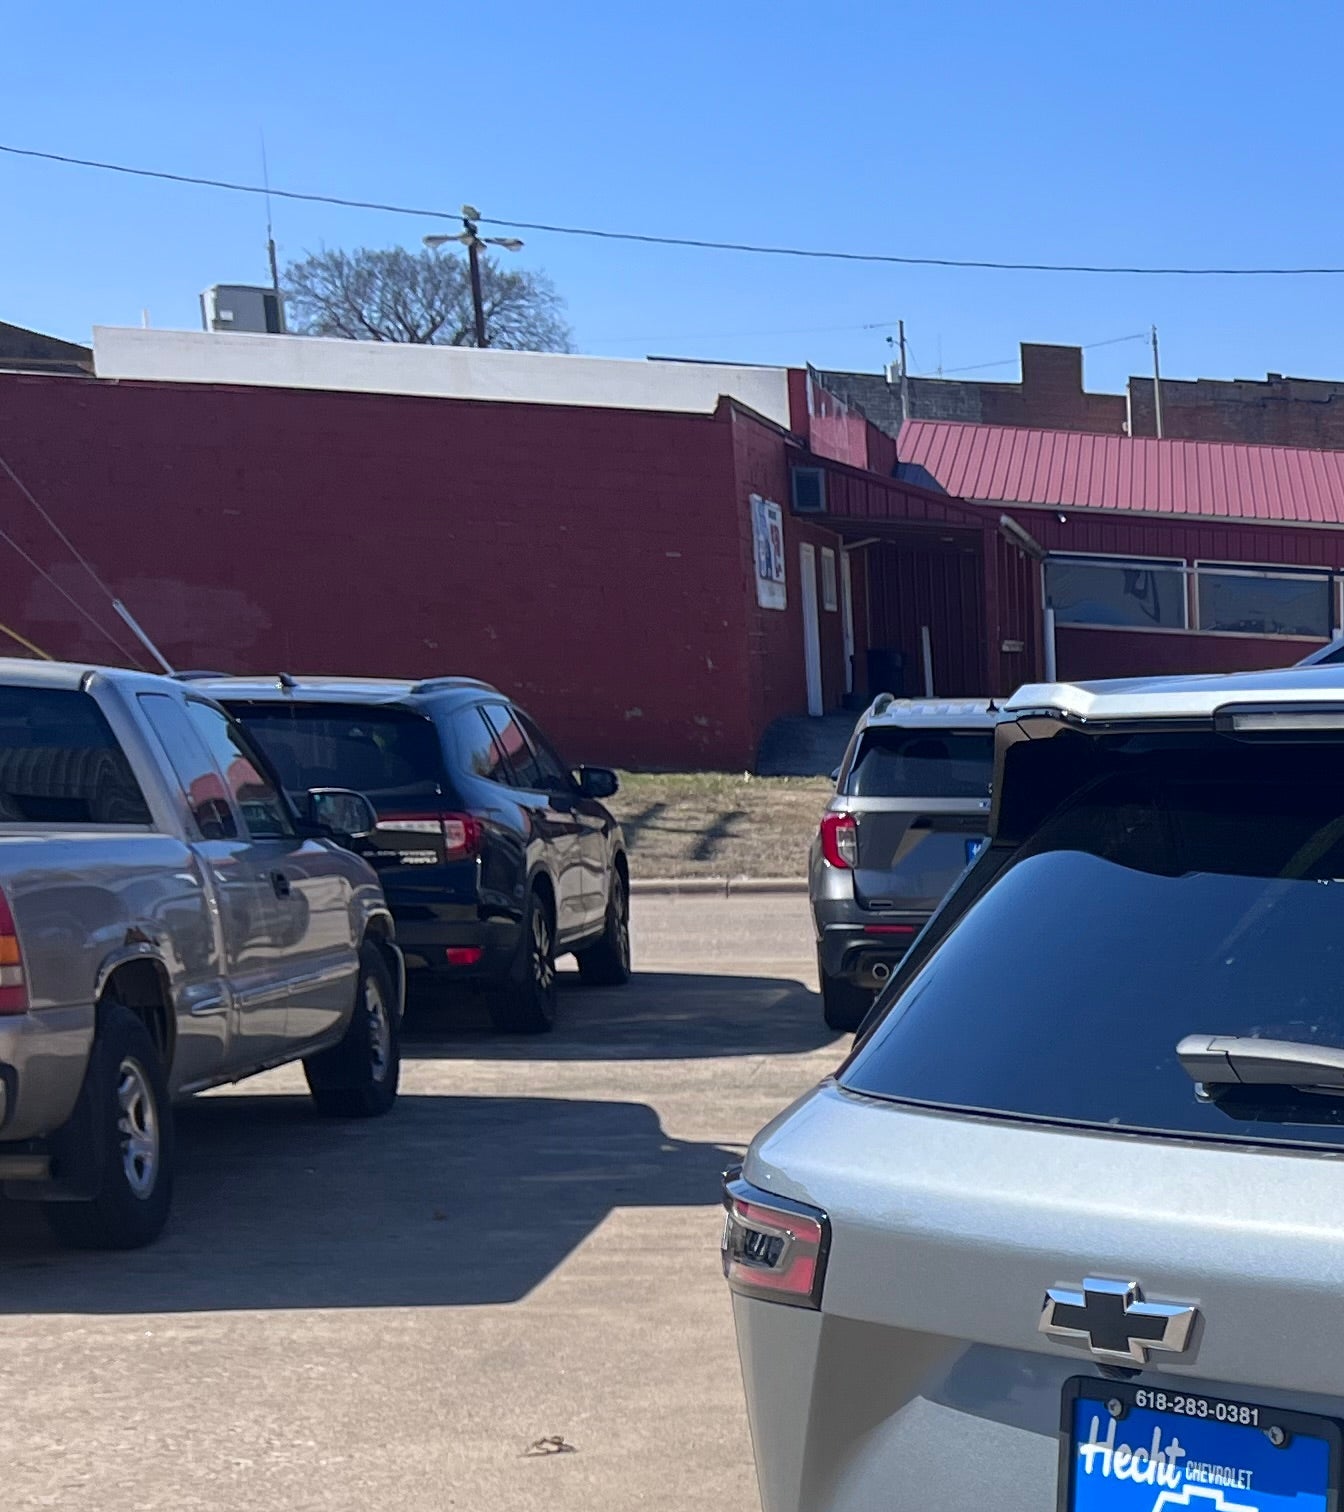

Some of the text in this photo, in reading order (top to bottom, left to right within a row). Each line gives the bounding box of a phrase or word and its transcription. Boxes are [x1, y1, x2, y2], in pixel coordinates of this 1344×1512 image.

[1135, 1389, 1260, 1426] 618-283-0381
[1078, 1415, 1186, 1489] Hecht
[1185, 1460, 1253, 1491] CHEVROLET
